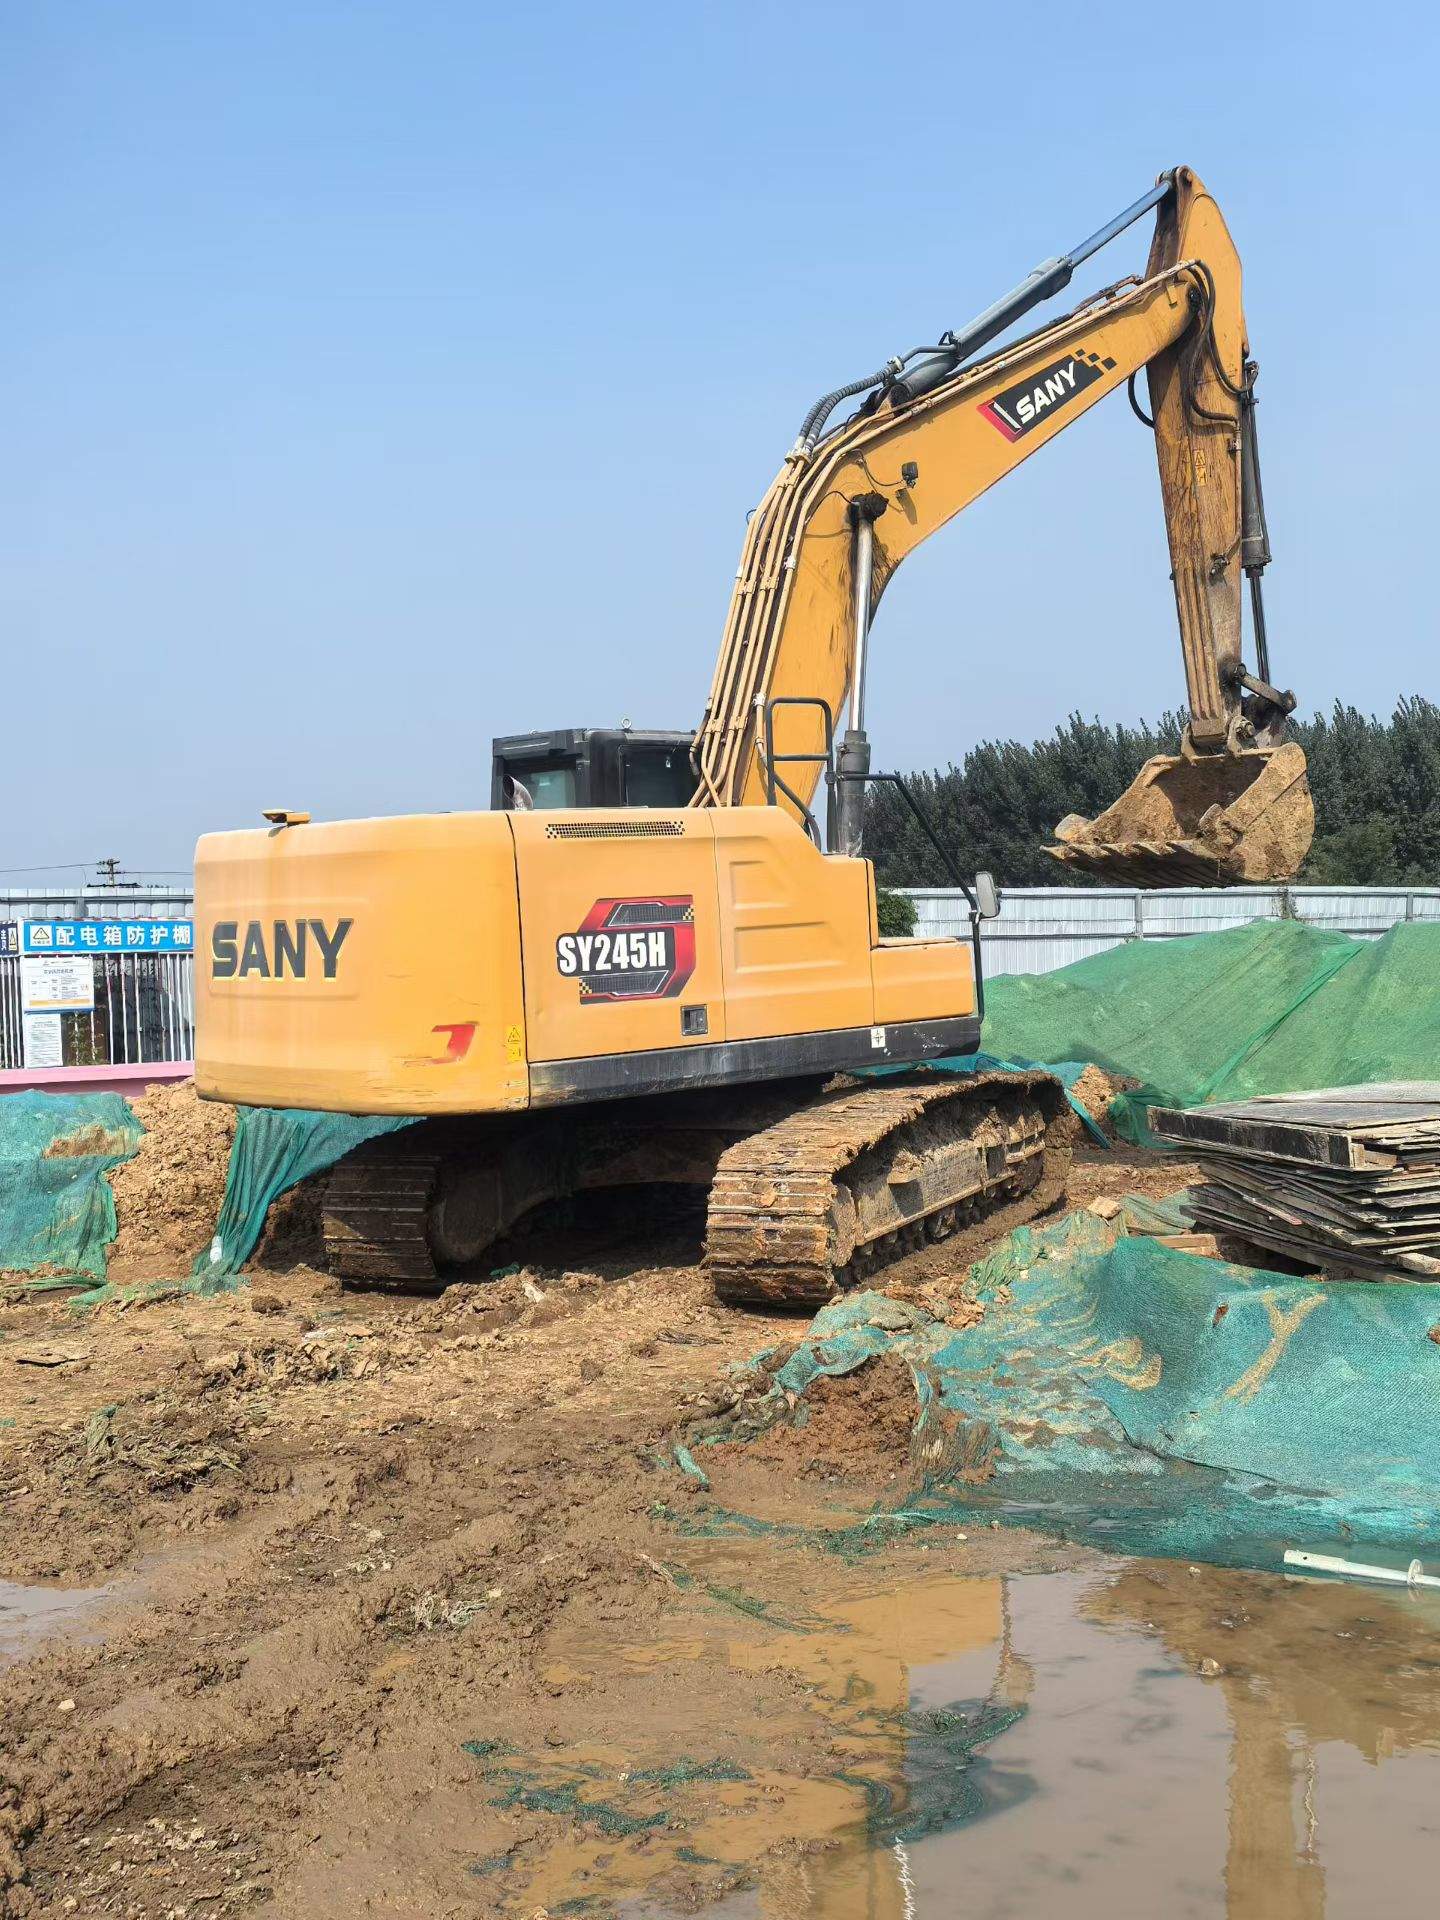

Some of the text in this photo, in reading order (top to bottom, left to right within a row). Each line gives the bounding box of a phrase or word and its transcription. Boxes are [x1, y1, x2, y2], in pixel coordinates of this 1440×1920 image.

[1016, 361, 1076, 424] SANY
[56, 925, 191, 946] 配电箱防护棚
[211, 919, 354, 979] SANY
[558, 931, 666, 974] SY245H
